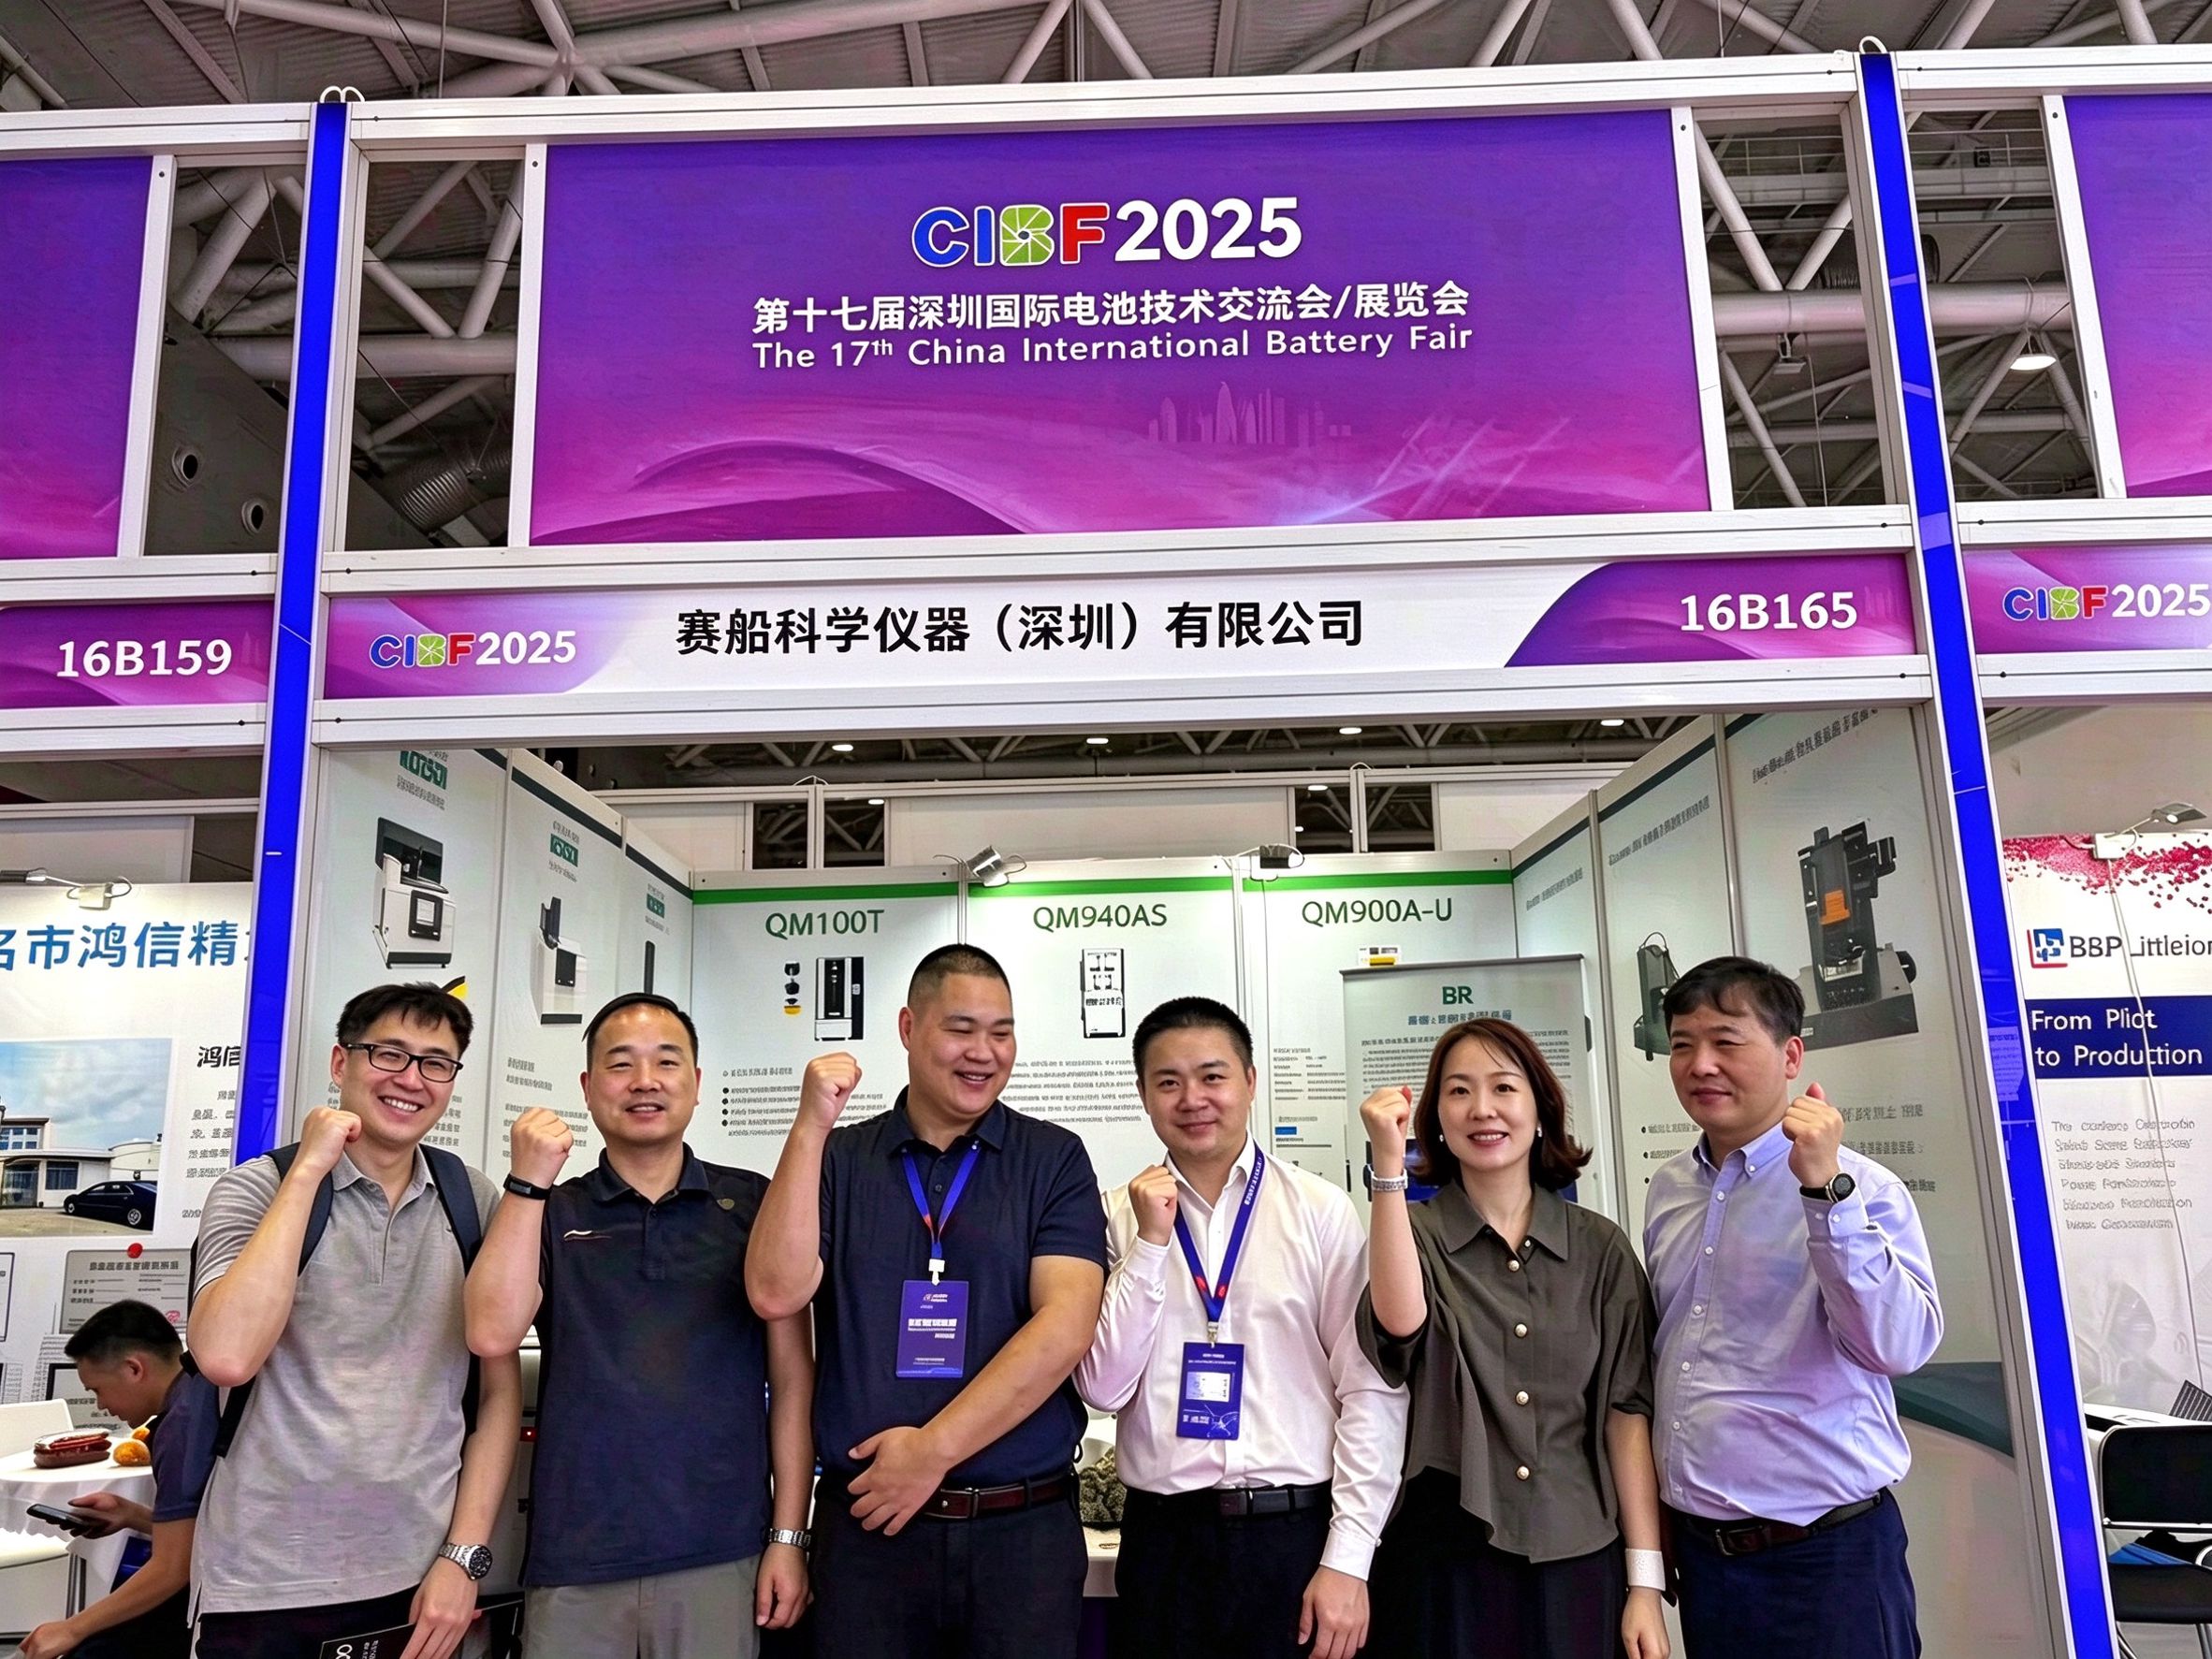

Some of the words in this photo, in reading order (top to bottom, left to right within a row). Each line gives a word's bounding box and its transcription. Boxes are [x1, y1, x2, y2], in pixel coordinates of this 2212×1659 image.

[752, 280, 1471, 335] 第十七届深圳国际电池技术交流会/展览会
[751, 342, 815, 369] The
[831, 339, 894, 367] 17th
[908, 337, 1006, 366] China
[1024, 328, 1249, 362] International
[1265, 324, 1393, 358] Battery
[1410, 323, 1473, 350] Fair
[676, 600, 1362, 655] 赛船科学仪器（深圳）有限公司
[1681, 591, 1857, 632] 16B165
[57, 639, 233, 677] 16B159
[764, 909, 885, 941] QM100T
[1033, 903, 1168, 933] QM940AS
[1302, 897, 1452, 927] QM900A-U
[0, 920, 250, 972] 市鸿信精
[1442, 985, 1474, 1005] BR
[2031, 1010, 2093, 1031] From
[2034, 1047, 2060, 1068] to
[2074, 1042, 2203, 1068] Production
